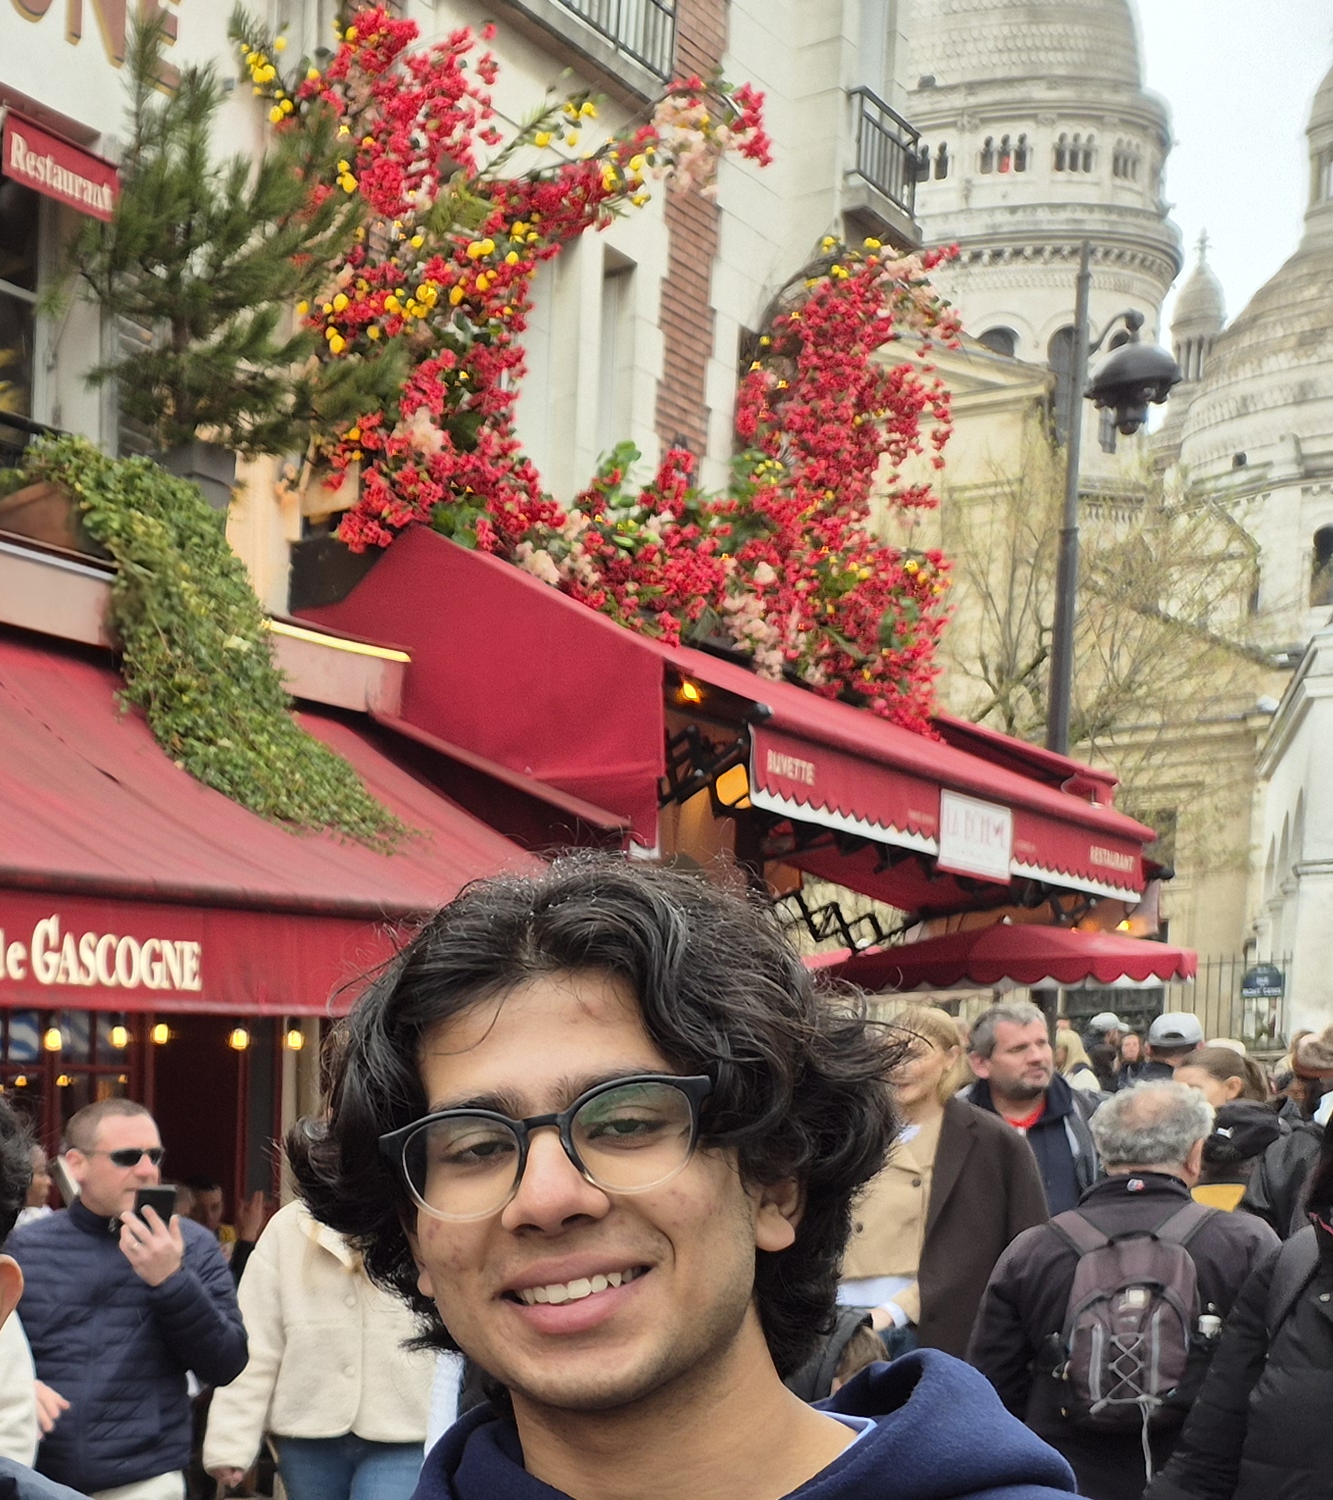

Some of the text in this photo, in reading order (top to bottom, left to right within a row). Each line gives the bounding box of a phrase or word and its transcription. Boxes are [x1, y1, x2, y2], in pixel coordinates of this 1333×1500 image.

[10, 131, 113, 213] Restaurant
[767, 749, 815, 786] BUVETTE
[1090, 845, 1134, 872] RESTAURANT
[31, 915, 201, 991] GASCOGNE
